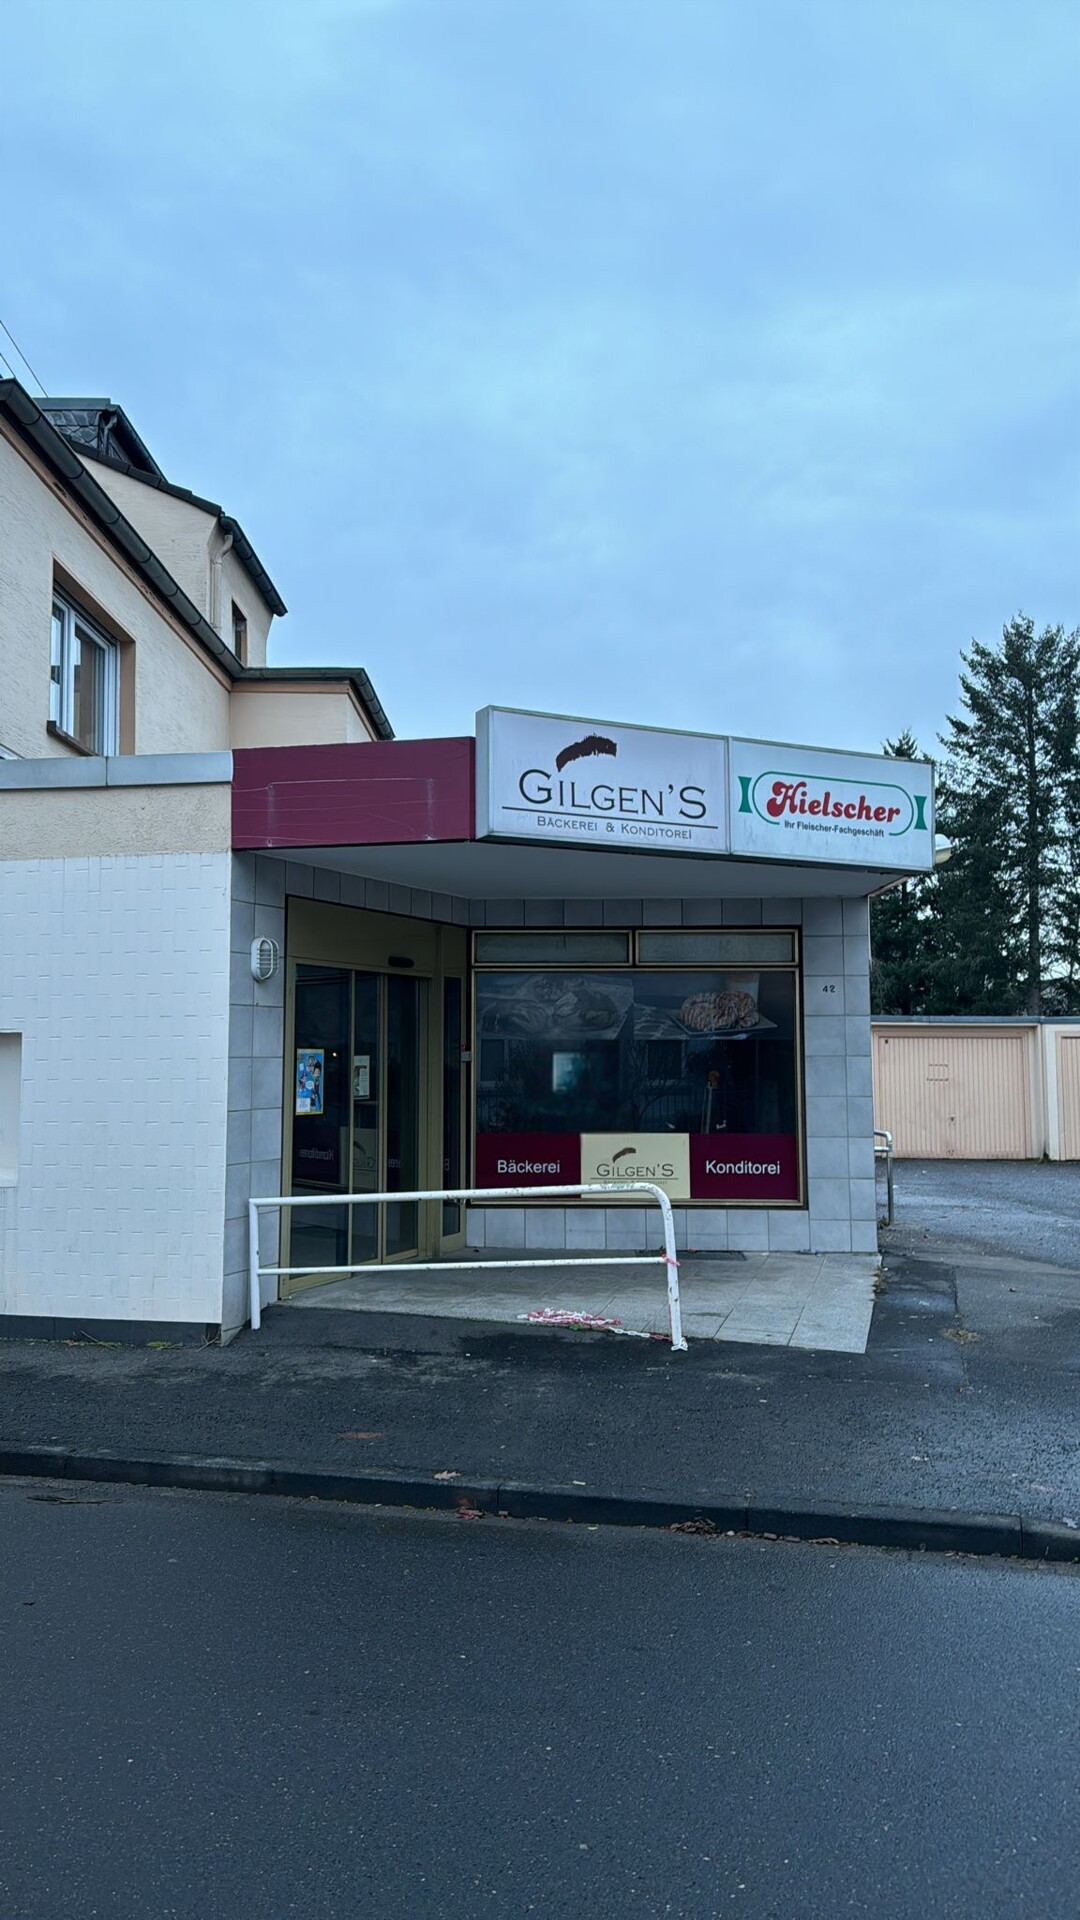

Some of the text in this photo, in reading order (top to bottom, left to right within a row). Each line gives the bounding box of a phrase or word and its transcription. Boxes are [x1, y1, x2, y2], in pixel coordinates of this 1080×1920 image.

[519, 768, 707, 819] GILGEN'S
[766, 781, 901, 823] Hielscher
[605, 823, 615, 833] &
[621, 823, 692, 839] KONDITOREI
[784, 819, 885, 837] Ihr Fleischer-Fachgeschäft
[822, 985, 835, 993] 42
[497, 1160, 561, 1174] Bäckerei
[596, 1163, 674, 1177] GILGEN'S
[706, 1160, 780, 1175] Konditorei
